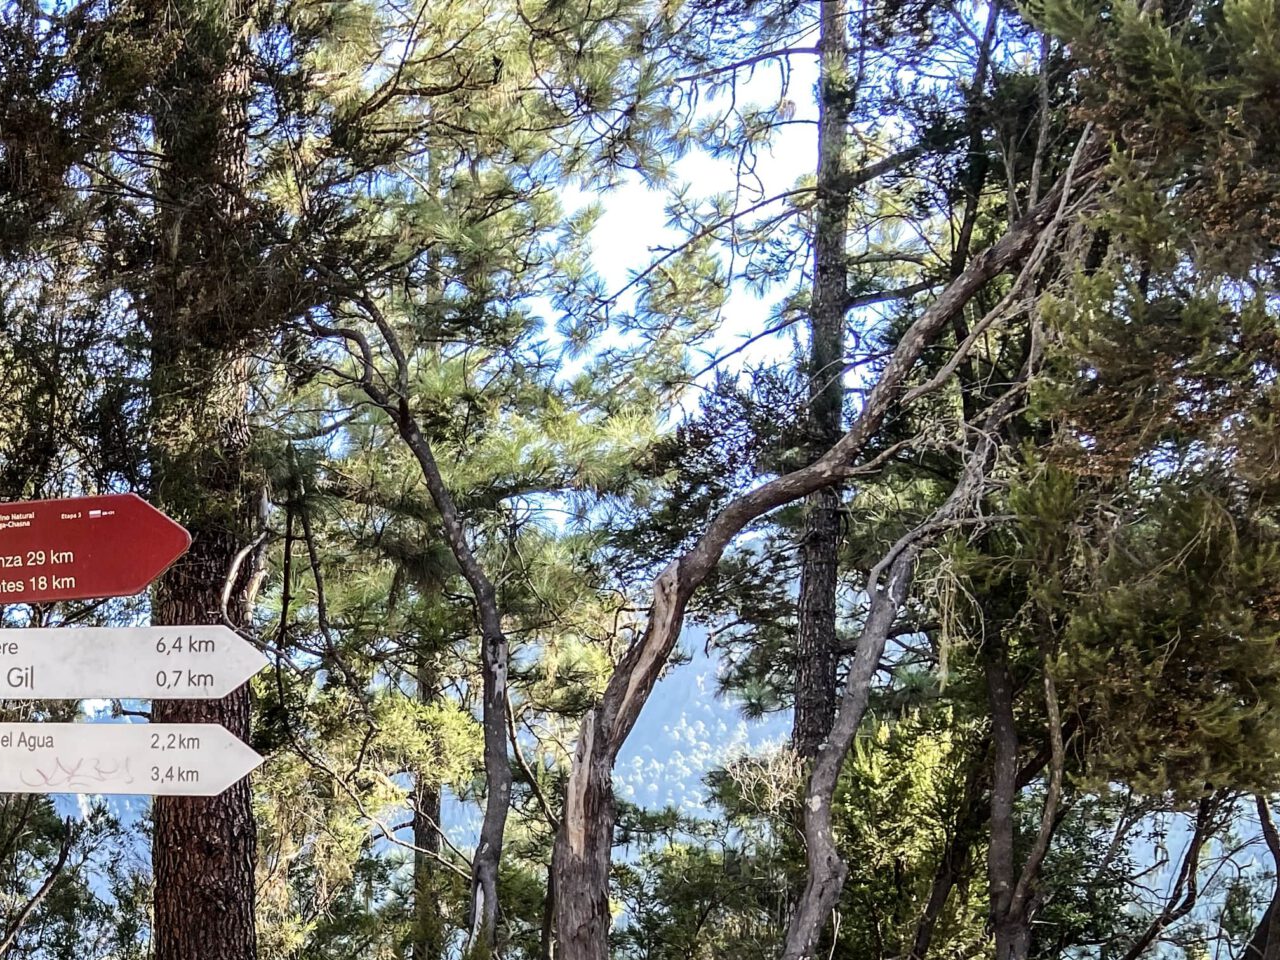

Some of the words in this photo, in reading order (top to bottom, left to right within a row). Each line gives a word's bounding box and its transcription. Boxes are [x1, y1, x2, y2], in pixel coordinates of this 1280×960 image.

[11, 511, 35, 519] Natural
[27, 551, 45, 565] 29
[50, 549, 74, 565] km
[29, 576, 48, 591] 18
[52, 574, 76, 590] km
[155, 636, 184, 655] 6,4
[188, 635, 216, 653] km
[6, 665, 35, 690] Gil
[155, 669, 183, 688] 0,7
[187, 670, 215, 687] km
[17, 732, 55, 752] Agua
[150, 733, 176, 751] 2,2
[178, 733, 200, 750] km
[150, 766, 175, 784] 3,4
[177, 766, 199, 782] km
